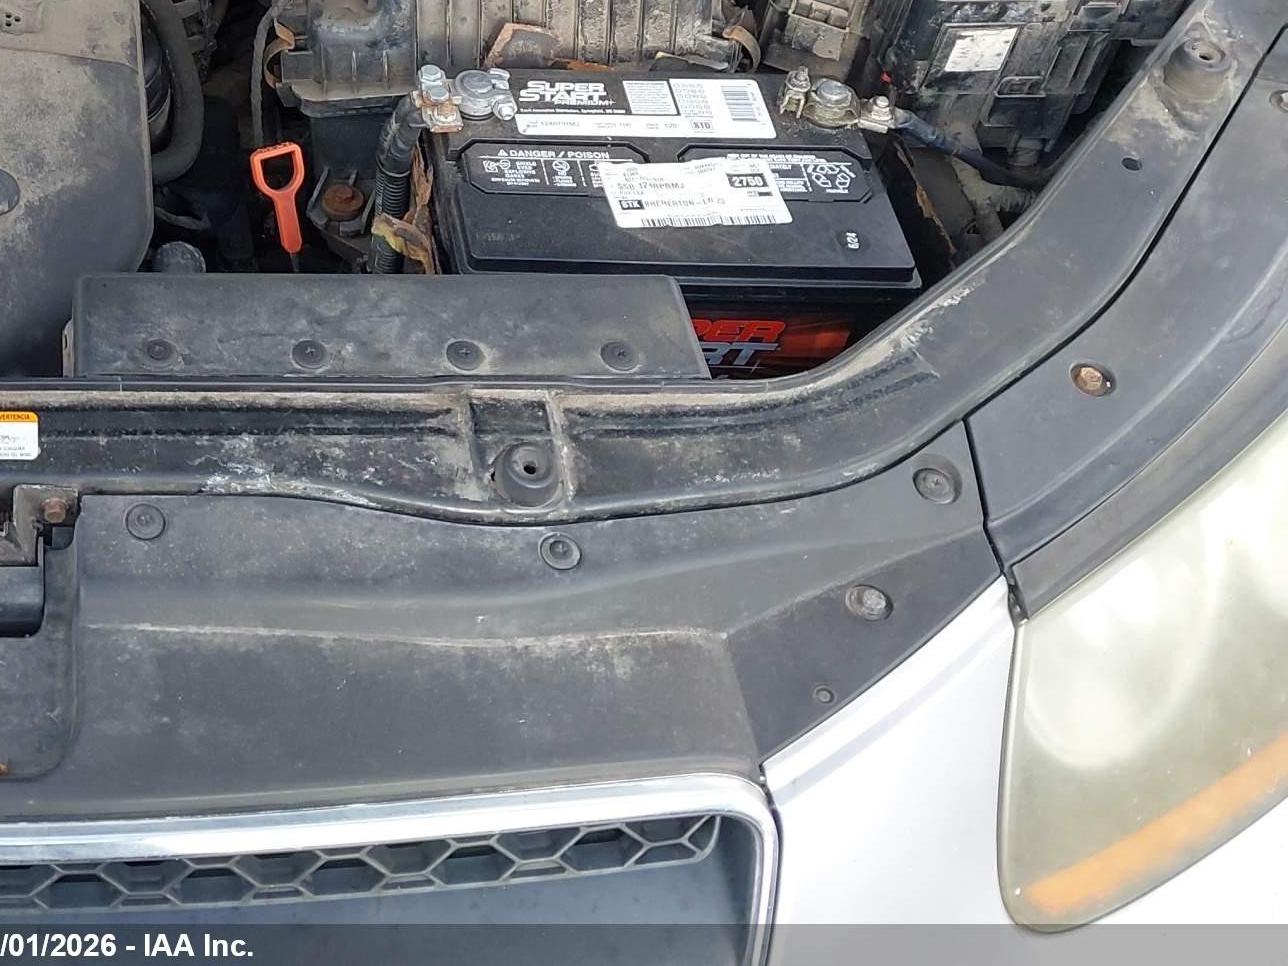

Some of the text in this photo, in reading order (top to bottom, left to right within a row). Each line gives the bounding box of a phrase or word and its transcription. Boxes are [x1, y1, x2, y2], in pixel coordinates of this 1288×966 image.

[527, 80, 605, 92] SUPER
[519, 89, 608, 102] START
[510, 150, 556, 158] DANGER
[568, 151, 610, 159] POISON
[732, 176, 764, 187] 2750
